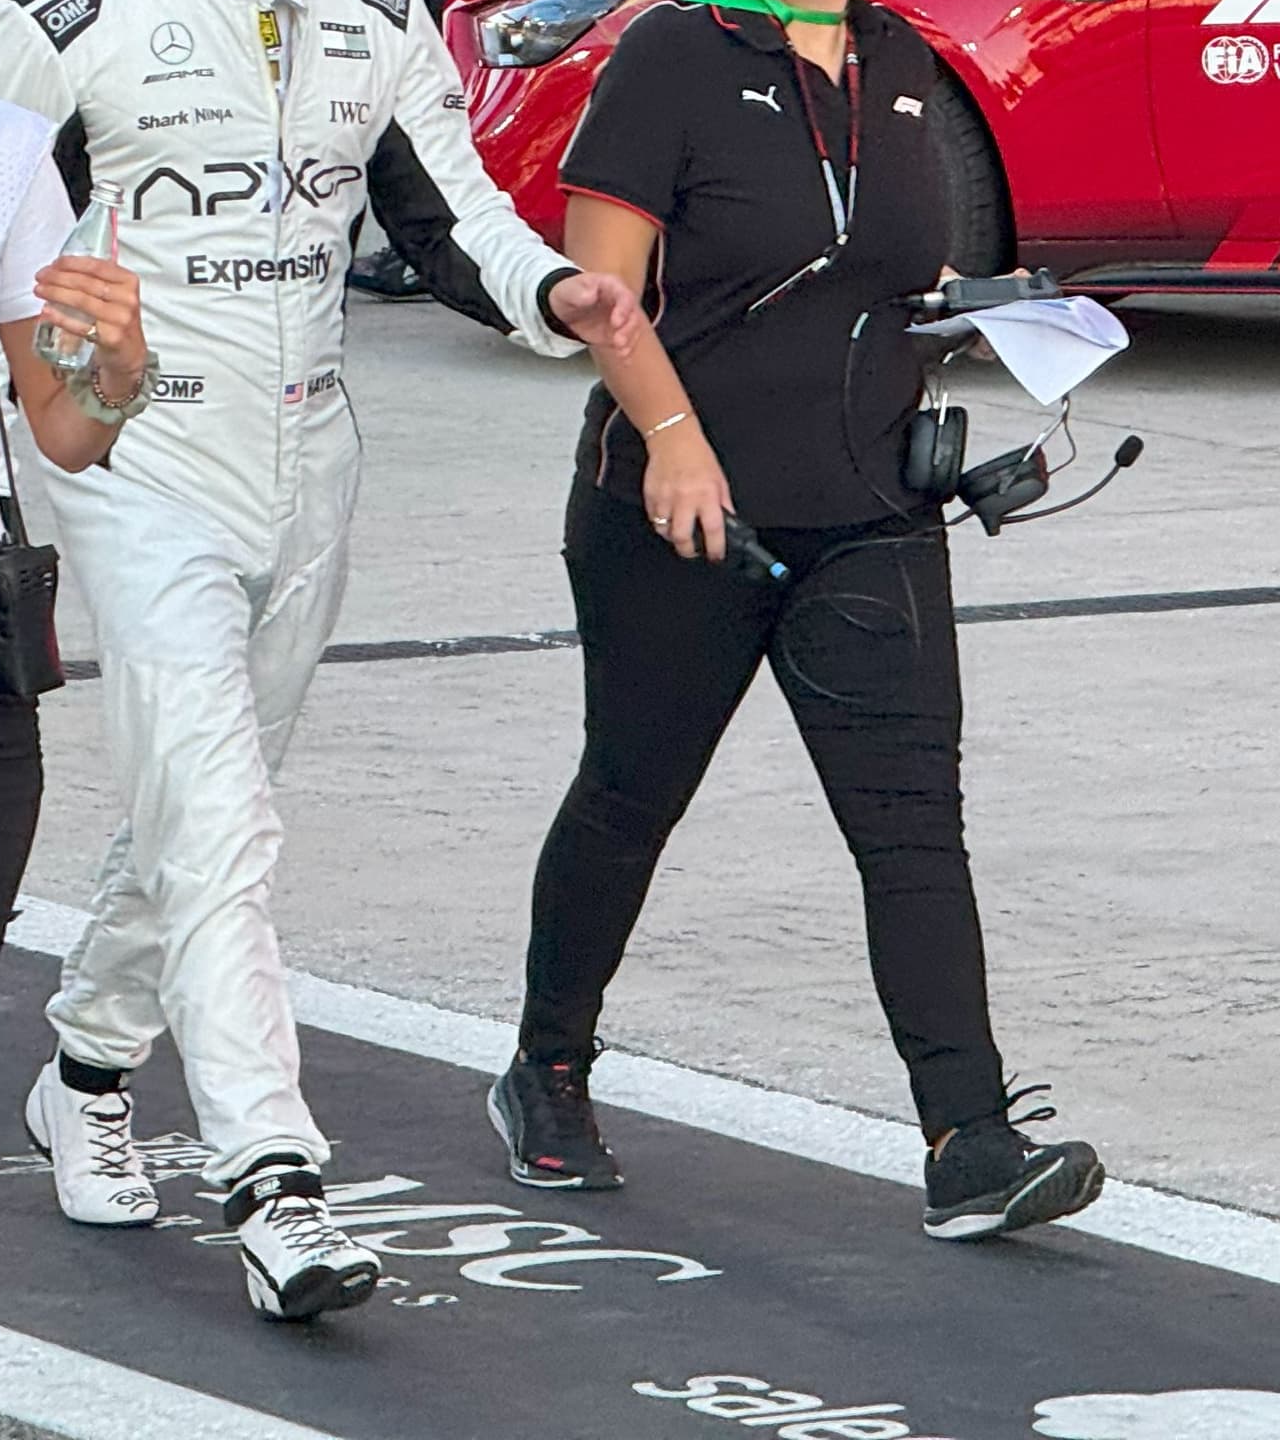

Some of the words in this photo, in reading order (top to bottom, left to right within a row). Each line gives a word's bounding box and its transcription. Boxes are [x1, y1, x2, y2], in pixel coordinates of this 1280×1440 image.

[137, 111, 189, 131] Shark
[329, 100, 370, 125] IWC
[186, 242, 333, 292] Expensify
[154, 379, 204, 399] OMP
[631, 1373, 920, 1440] sale
